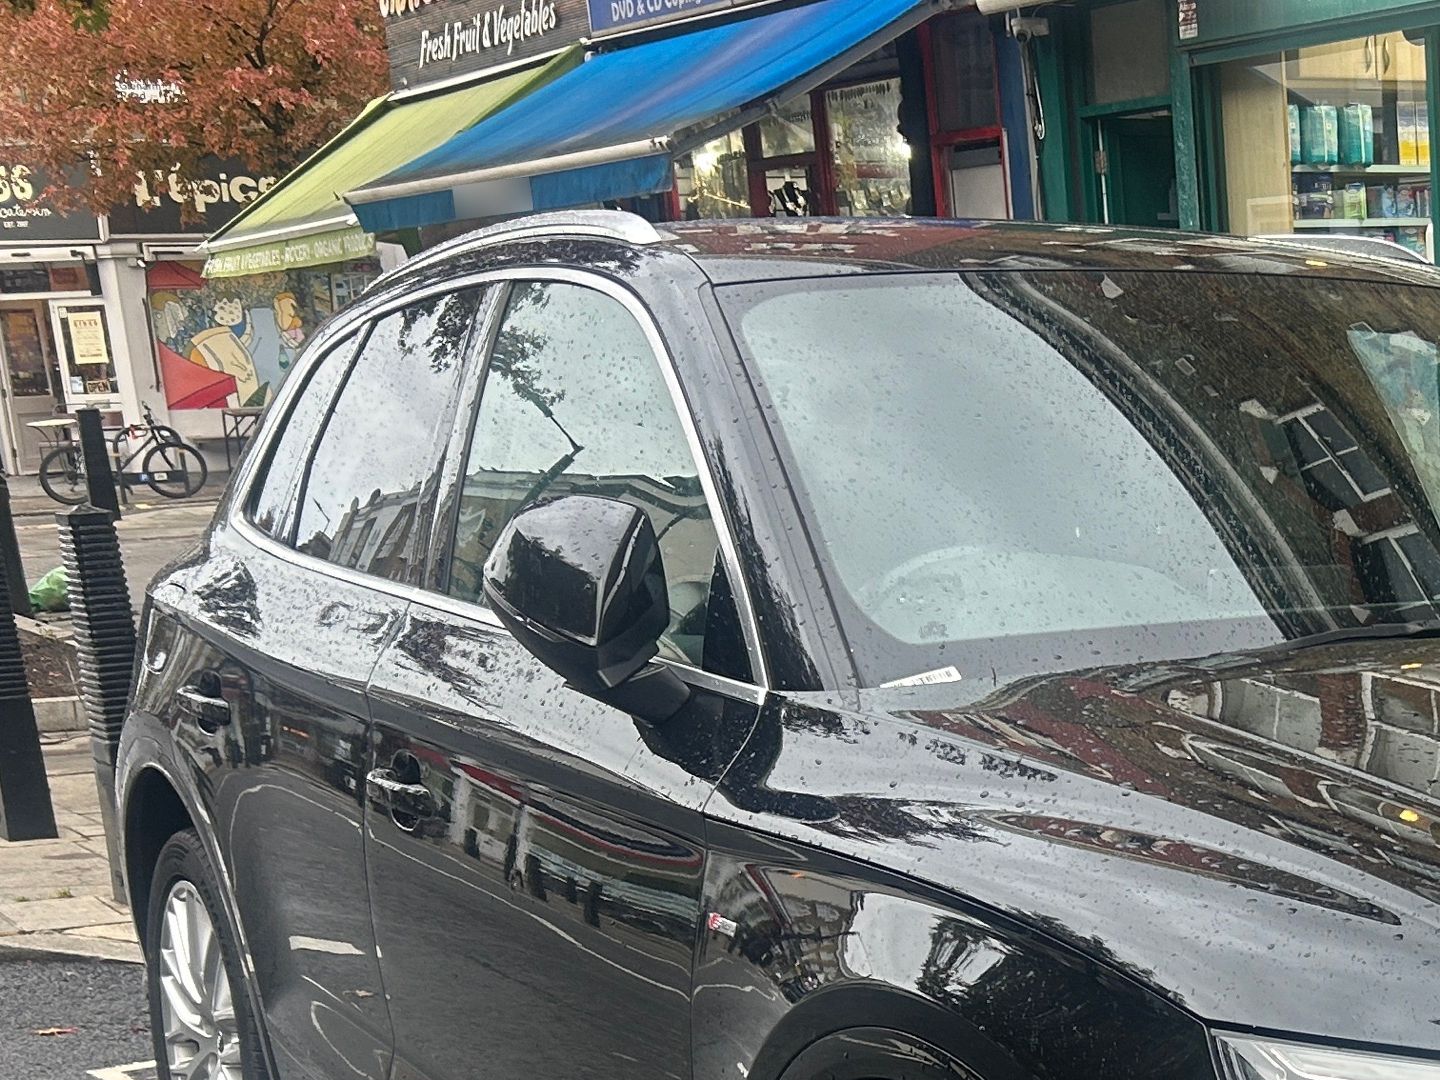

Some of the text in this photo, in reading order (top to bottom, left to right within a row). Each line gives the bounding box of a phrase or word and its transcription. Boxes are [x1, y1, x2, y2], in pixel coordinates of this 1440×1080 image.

[610, 0, 634, 21] DVD
[418, 3, 556, 69] Fresh Fruit & Vegetables
